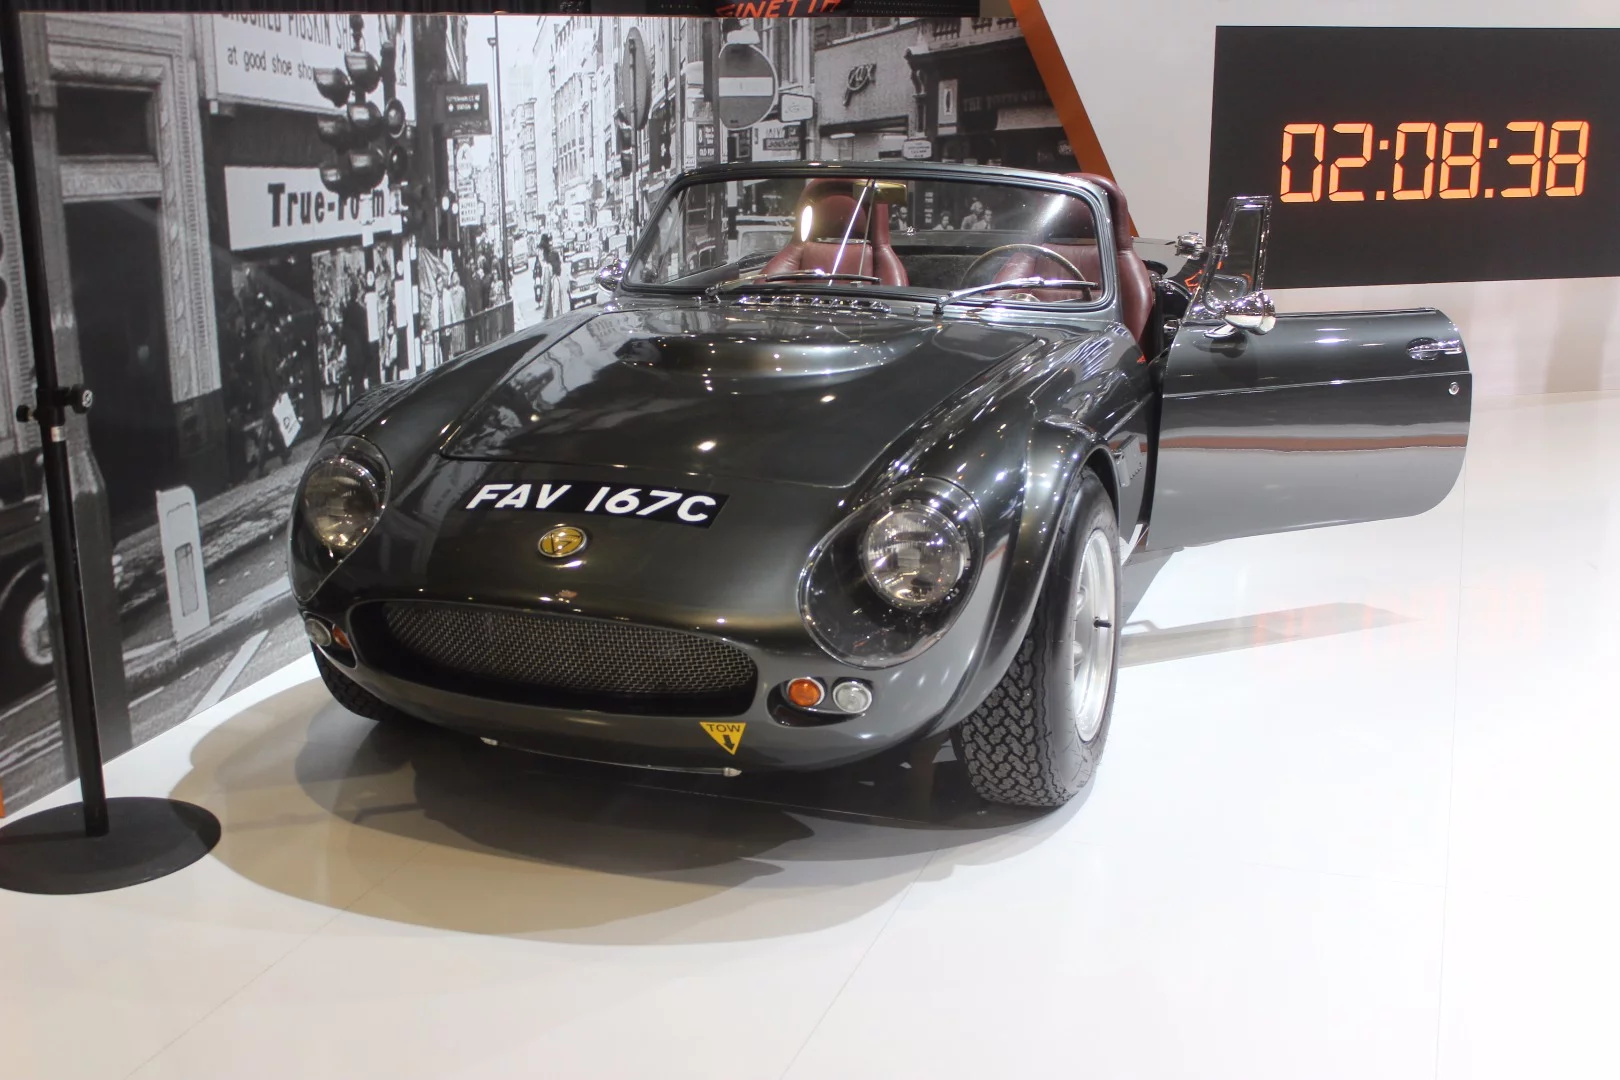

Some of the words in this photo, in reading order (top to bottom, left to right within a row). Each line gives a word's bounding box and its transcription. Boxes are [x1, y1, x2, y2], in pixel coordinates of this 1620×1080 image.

[227, 45, 238, 65] at
[243, 50, 267, 72] good
[271, 53, 293, 77] shoe
[297, 59, 315, 84] sho
[1279, 120, 1590, 203] 02:08:38
[465, 483, 572, 510] FAV
[584, 486, 717, 523] 167C
[705, 723, 741, 733] TOW
